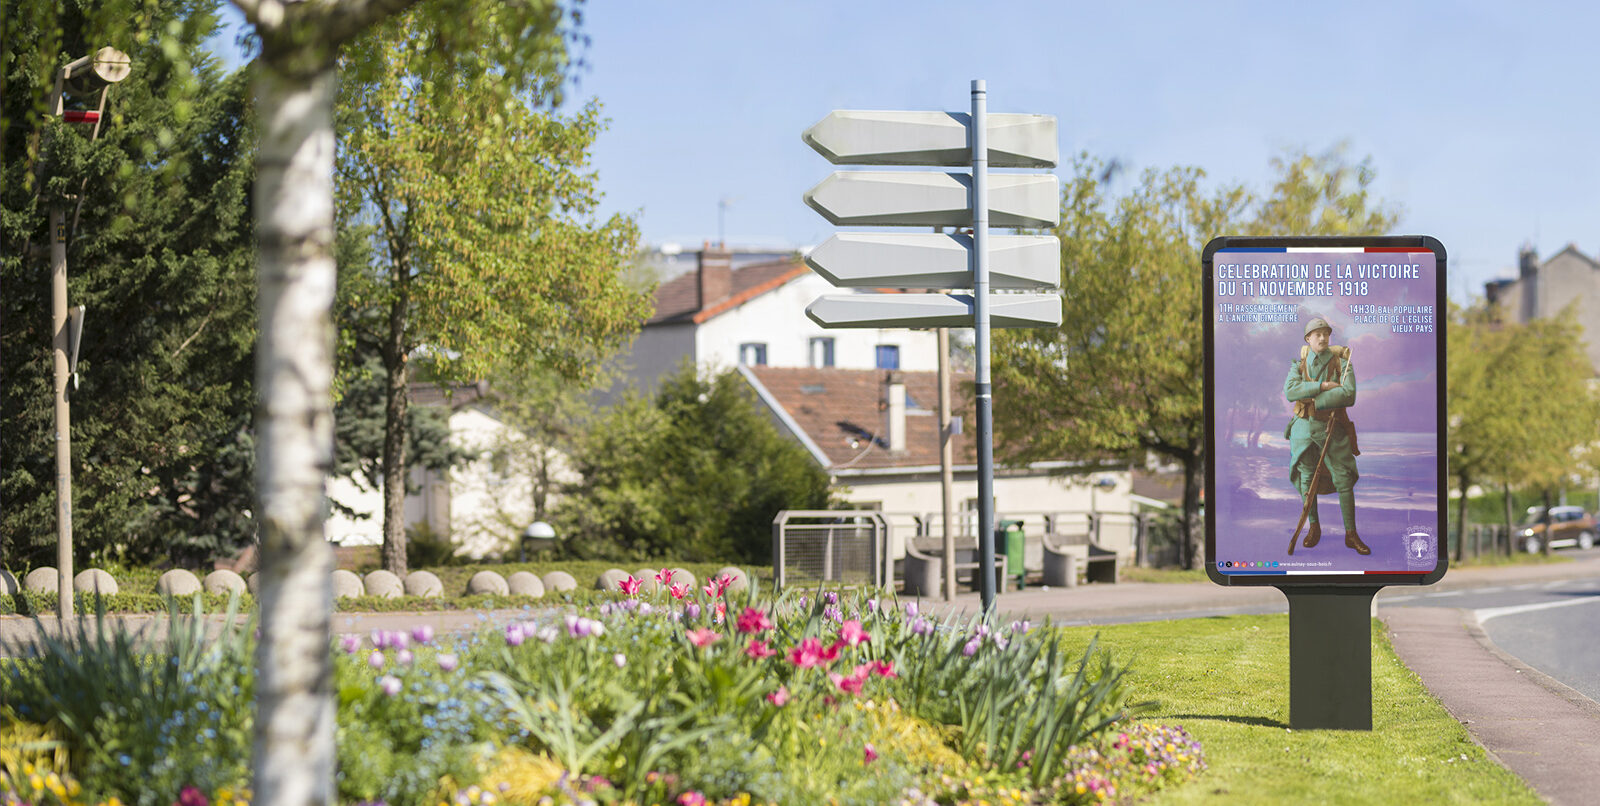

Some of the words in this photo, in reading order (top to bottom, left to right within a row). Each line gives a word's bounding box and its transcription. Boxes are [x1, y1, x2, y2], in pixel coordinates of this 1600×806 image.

[1219, 264, 1309, 279] CELEBRATION
[1315, 264, 1331, 279] DE
[1336, 264, 1353, 279] LA
[1358, 264, 1420, 279] VICTOIRE
[1219, 281, 1236, 296] DU
[1241, 281, 1254, 296] 11
[1259, 281, 1333, 296] NOVEMBRE
[1338, 281, 1369, 296] 1918
[1219, 303, 1233, 313] 11H
[1235, 304, 1298, 313] RASSEMBLEMENT
[1349, 304, 1375, 314] 14H30
[1377, 305, 1391, 314] BAL
[1393, 305, 1433, 314] POPULAIRE
[1218, 314, 1224, 322] A
[1225, 314, 1258, 322] L'ANCIEN
[1354, 315, 1377, 324] PLACE
[1379, 315, 1389, 324] DE
[1390, 315, 1400, 324] DE
[1402, 315, 1433, 324] L'EGLISE
[1392, 324, 1413, 333] VIEUX
[1415, 324, 1433, 333] PAYS
